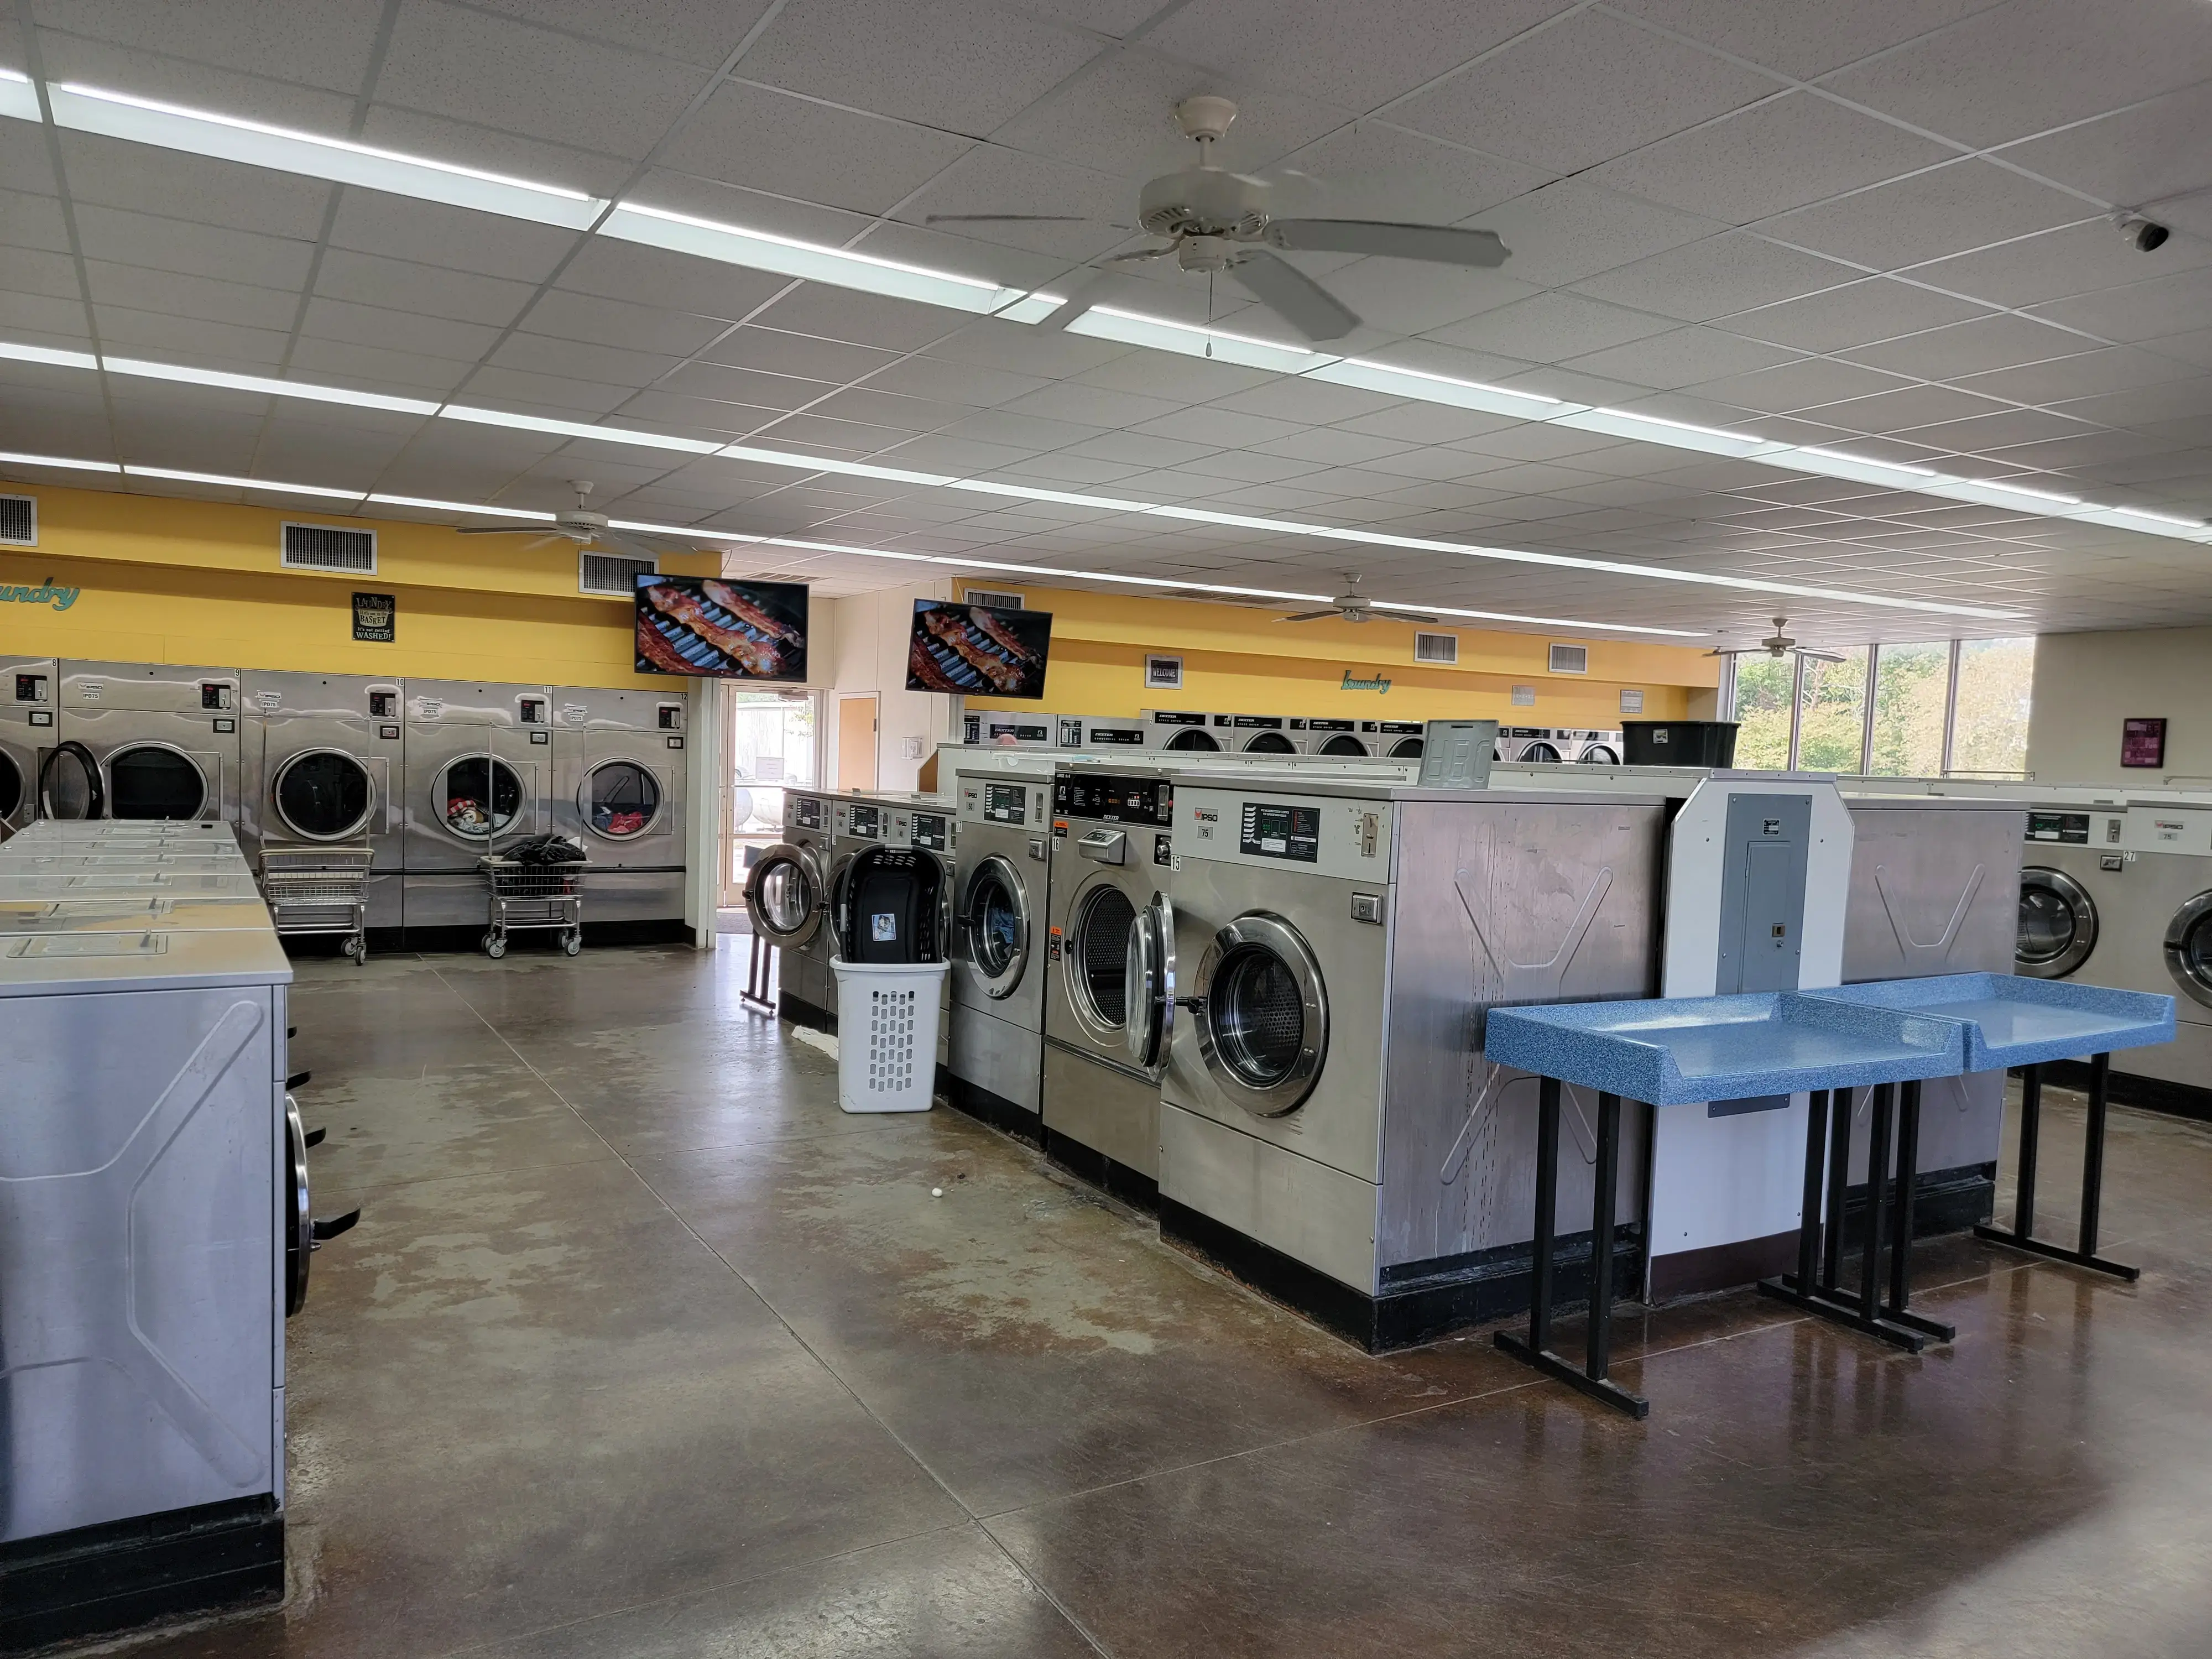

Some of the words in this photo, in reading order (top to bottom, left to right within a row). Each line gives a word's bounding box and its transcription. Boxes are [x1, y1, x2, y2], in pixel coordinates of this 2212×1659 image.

[356, 597, 392, 610] LAUNDRY
[360, 615, 385, 624] BASKET
[356, 632, 391, 640] WASHED!
[1152, 667, 1176, 677] WELCOME
[1201, 813, 1218, 822] IPSO
[957, 821, 962, 832] 17
[1202, 829, 1209, 837] 75
[1053, 838, 1059, 851] 16
[2124, 851, 2135, 861] 27
[1172, 856, 1180, 870] 15
